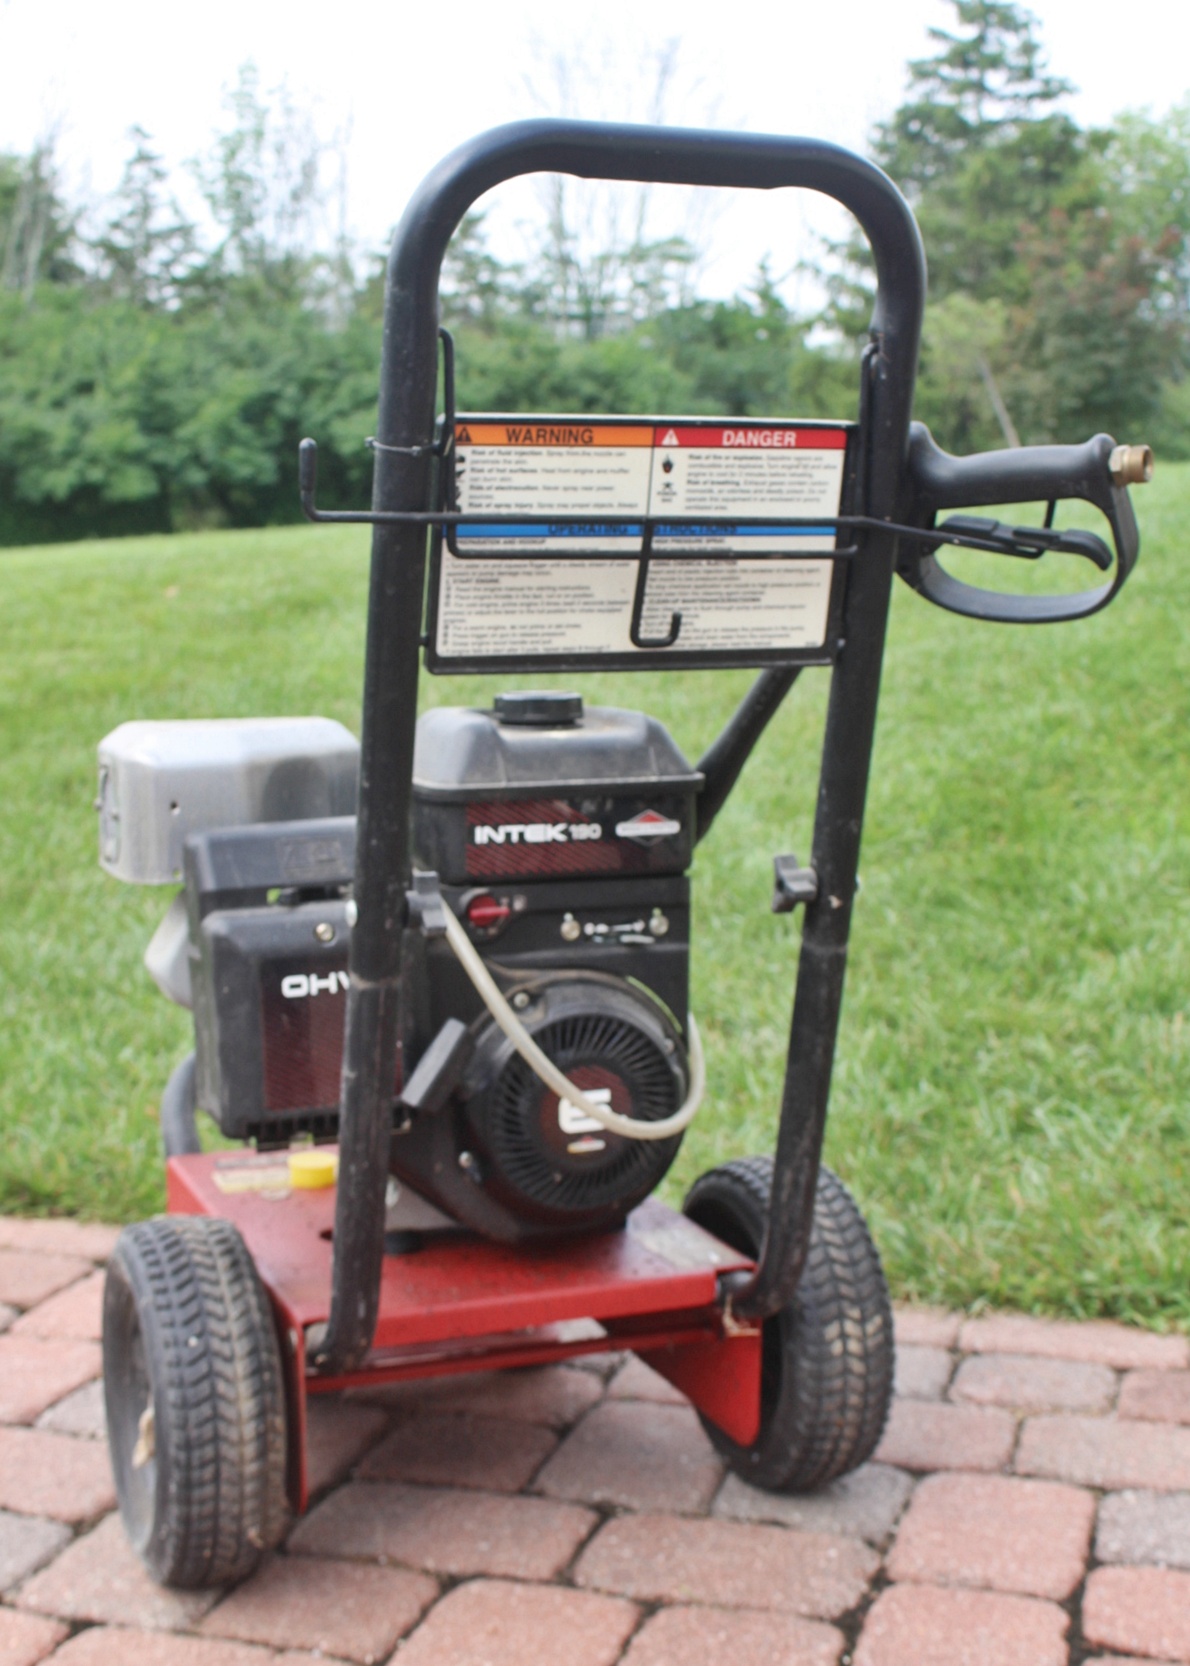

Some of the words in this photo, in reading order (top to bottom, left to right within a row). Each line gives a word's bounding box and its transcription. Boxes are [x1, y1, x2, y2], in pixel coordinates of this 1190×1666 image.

[506, 428, 593, 443] WARNING
[722, 430, 797, 447] DANGER
[550, 524, 628, 536] OPERATING
[640, 524, 736, 536] ISTRUCTIONS
[474, 823, 568, 844] INTEK
